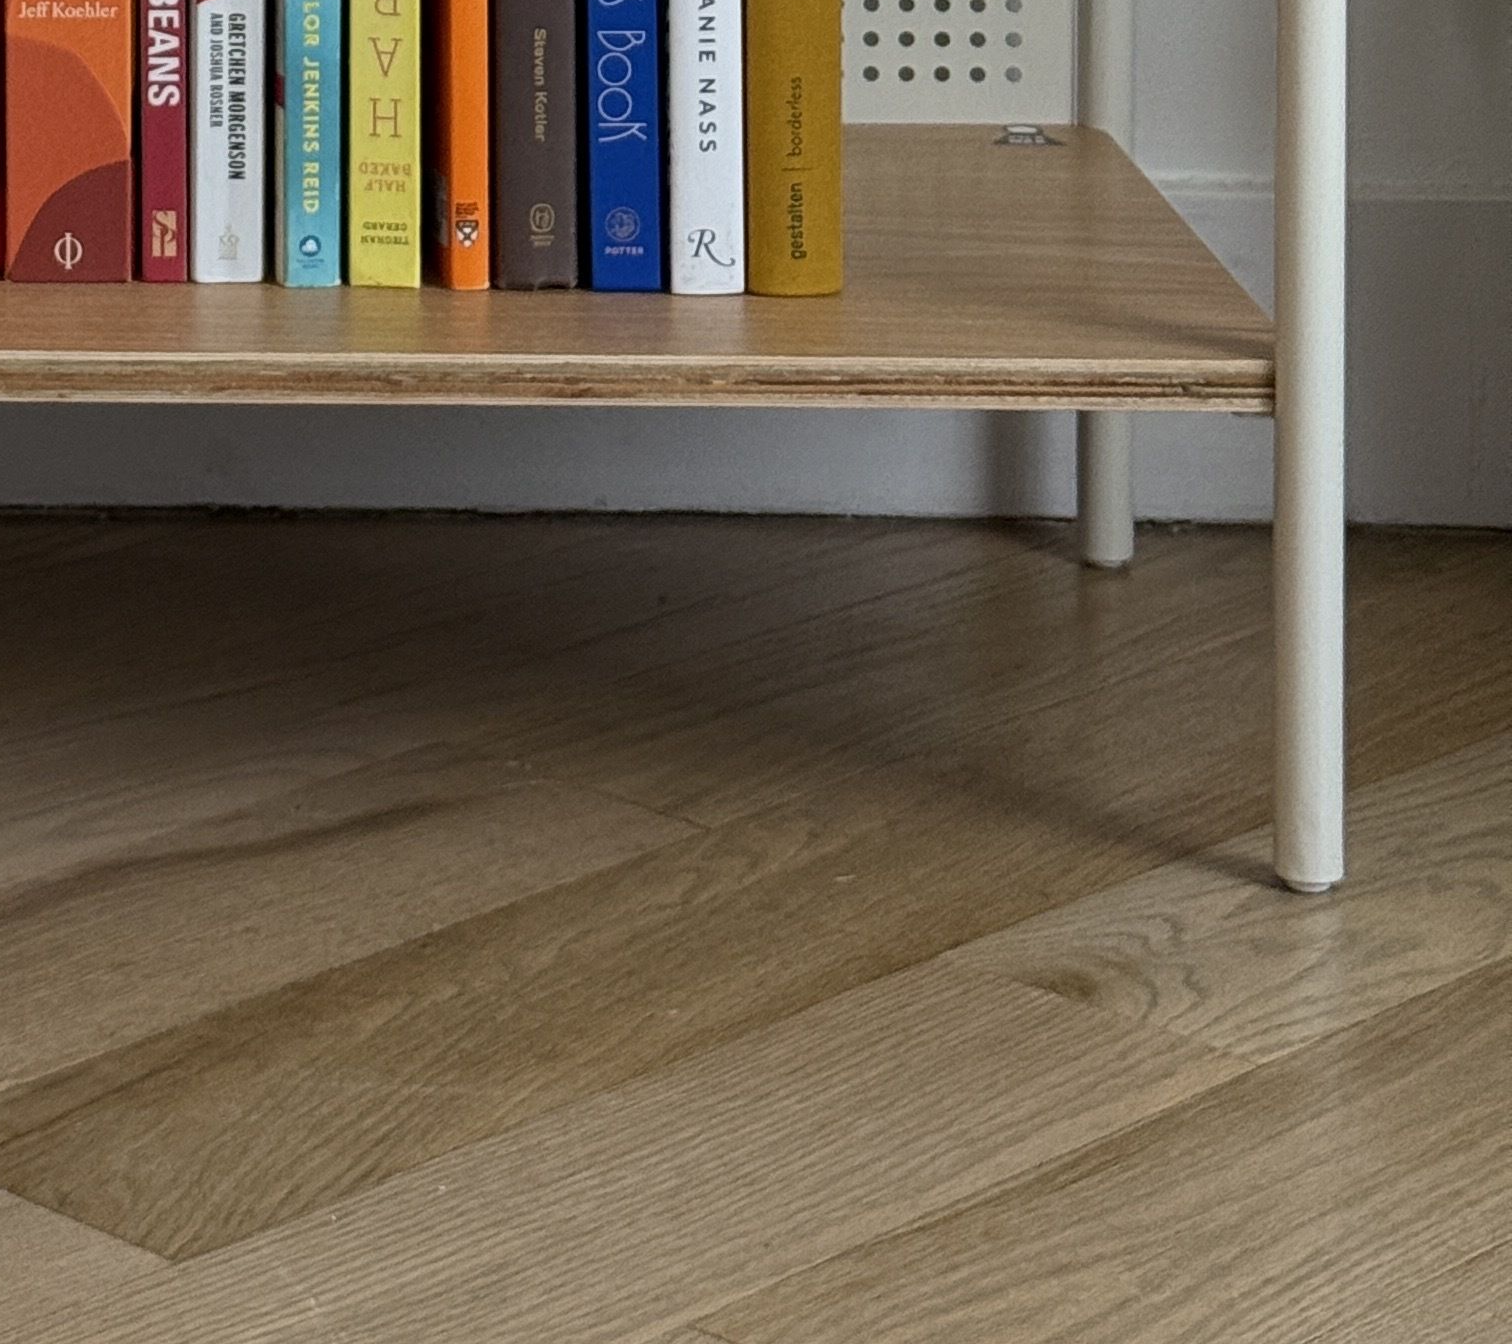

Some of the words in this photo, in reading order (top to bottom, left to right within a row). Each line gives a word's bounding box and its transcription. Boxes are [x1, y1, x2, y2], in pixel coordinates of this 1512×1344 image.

[18, 1, 50, 19] Jeff
[52, 1, 118, 18] Koehler
[210, 13, 223, 36] AND
[210, 40, 223, 82] JOSHUA
[228, 13, 246, 86] GRETCHEN
[533, 28, 547, 86] Steven
[210, 85, 223, 128] ROSNER
[303, 56, 319, 153] JENKINS
[534, 90, 548, 142] Kotler
[698, 78, 717, 153] NASS
[787, 76, 802, 157] borderless
[228, 92, 246, 180] MORGENSON
[302, 162, 319, 213] REID
[358, 163, 412, 176] BAKED
[365, 180, 405, 192] HALF
[787, 182, 806, 260] gestalten
[604, 245, 644, 254] POTTER
